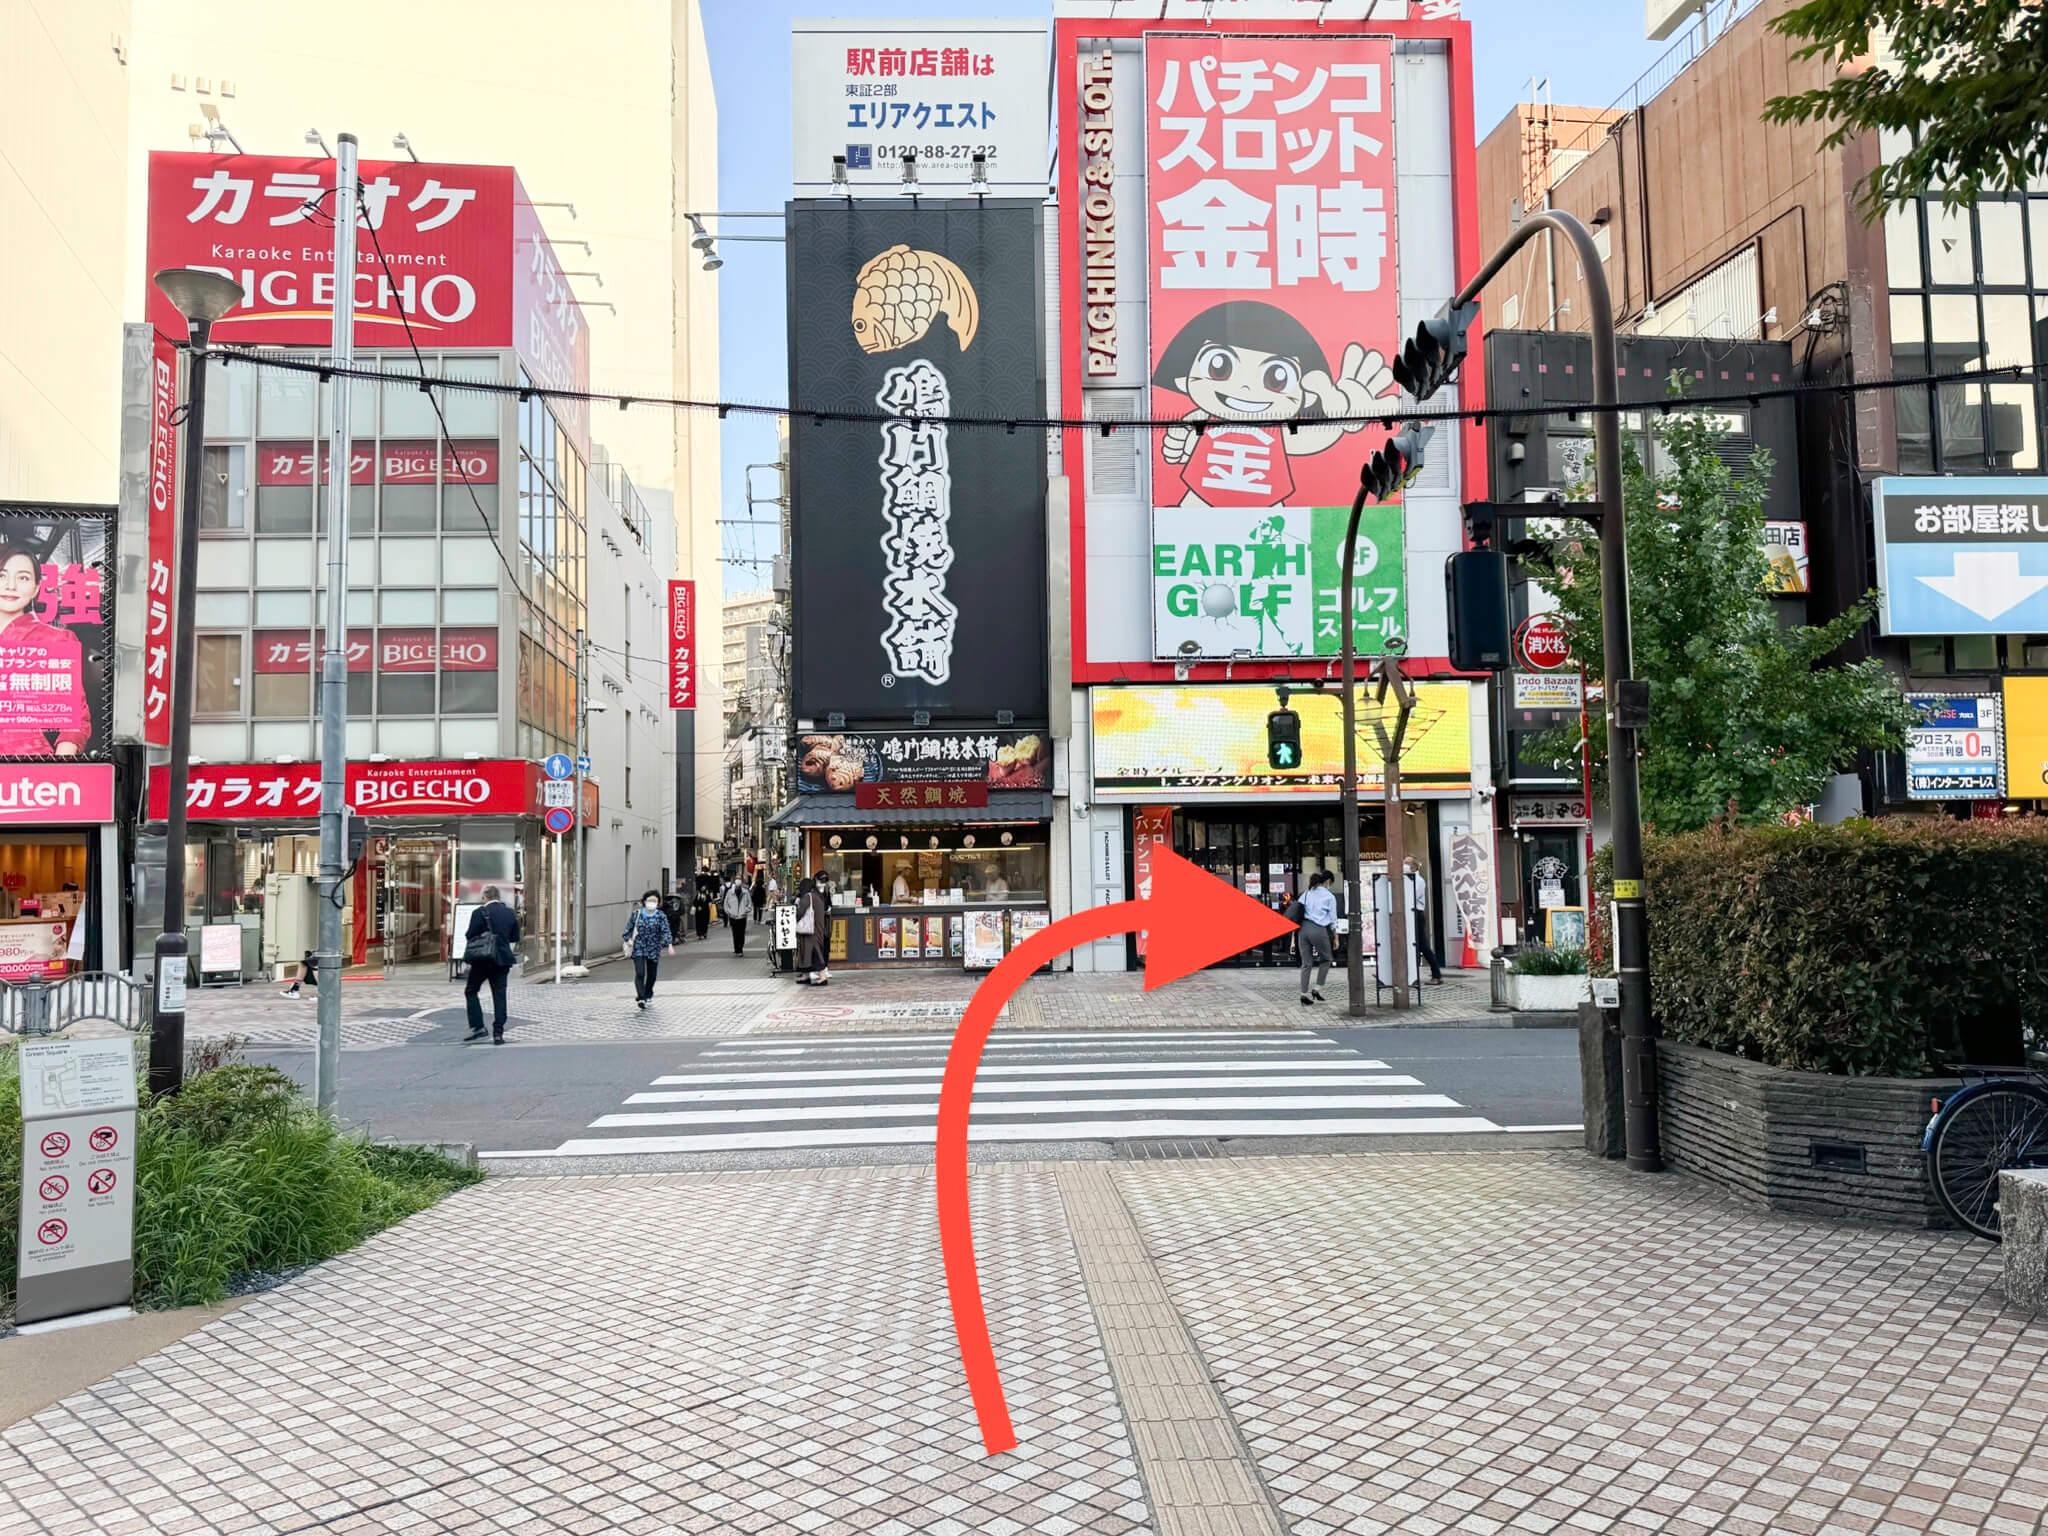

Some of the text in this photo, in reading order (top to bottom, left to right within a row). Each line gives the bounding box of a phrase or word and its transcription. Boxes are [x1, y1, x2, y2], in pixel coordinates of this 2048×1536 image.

[846, 48, 995, 77] 駅前店舗は
[845, 84, 898, 97] 東証2部
[1156, 55, 1381, 115] パチンコ
[848, 101, 996, 129] エリアクエスト
[877, 145, 998, 159] 0120-88-27-22
[1157, 117, 1383, 174] スロット
[187, 170, 477, 233] カラオケ
[1156, 178, 1387, 292] 金時
[211, 243, 448, 267] Karaoke Enttainment
[1086, 191, 1117, 377] PACHINKO
[153, 358, 170, 512] BIG ECHO
[385, 457, 489, 476] BIG ECHO
[1201, 426, 1276, 495] 金
[1155, 543, 1306, 577] EARTH
[36, 563, 104, 624] 強
[674, 586, 686, 640] BIG ECHO
[148, 559, 170, 720] カラオケ
[1528, 636, 1568, 654] 消火栓
[383, 644, 487, 665] BIG ECHO
[9, 672, 73, 692] 無制限
[675, 647, 690, 704] カラオケ
[1517, 677, 1579, 685] Indo Bazaar
[1980, 709, 1993, 718] 3F
[881, 735, 999, 762] 鳴門鯛焼本舗
[367, 767, 477, 776] Karaoke Entertainment
[1178, 775, 1288, 786] エヴァンゲリオン
[0, 777, 81, 806] uten
[186, 777, 322, 808] カラオケ
[355, 778, 491, 806] BIG ECHO
[876, 786, 968, 806] 天然鯛焼
[1136, 818, 1149, 873] パチンコ
[780, 908, 791, 948] たいやき
